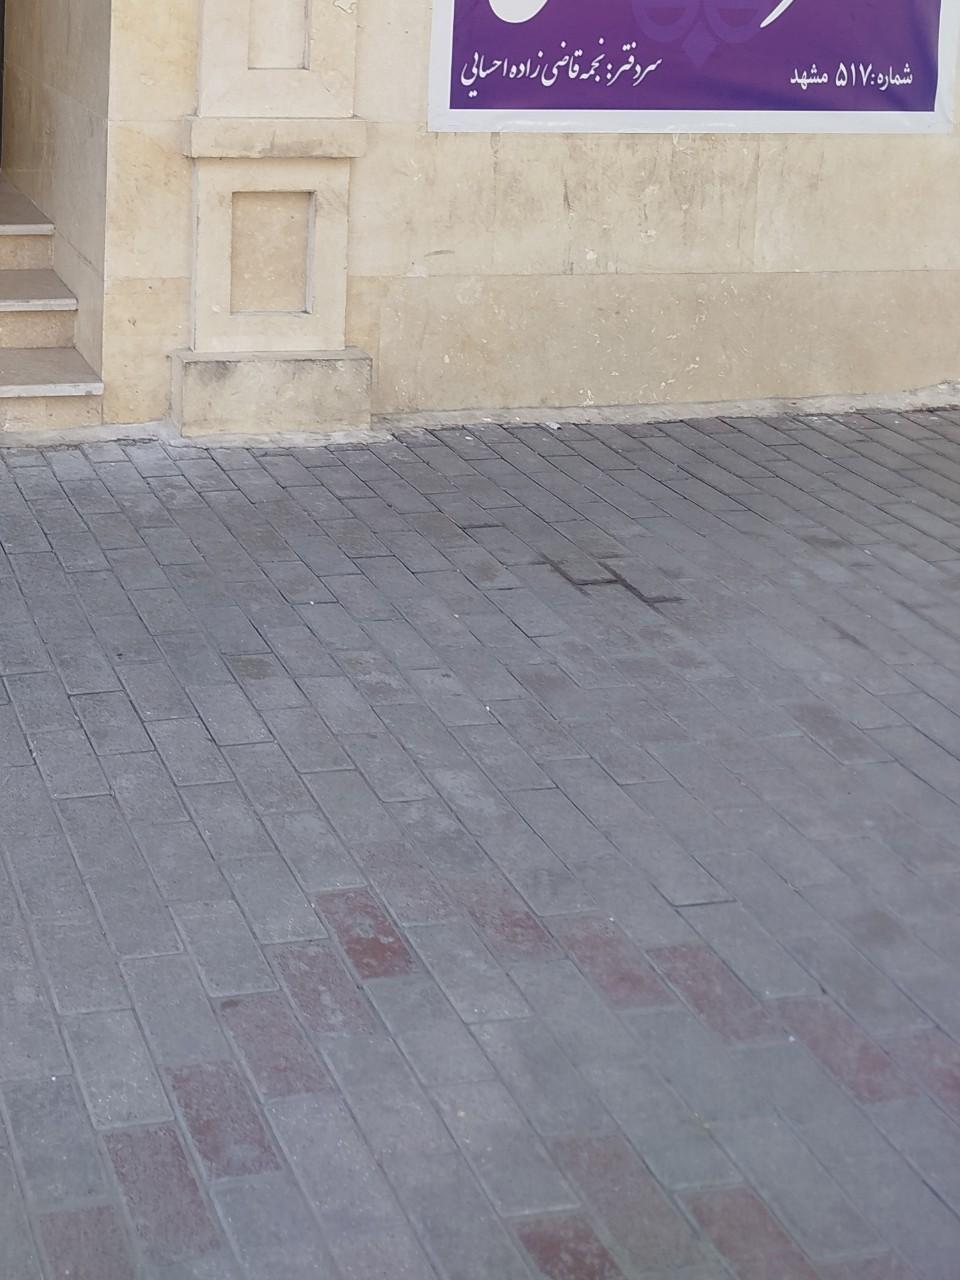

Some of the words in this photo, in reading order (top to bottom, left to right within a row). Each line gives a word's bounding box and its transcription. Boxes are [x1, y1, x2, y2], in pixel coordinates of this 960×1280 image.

[508, 49, 544, 79] زاده
[541, 40, 584, 87] قاضی
[579, 37, 606, 82] نجمه
[606, 41, 663, 87] سردفتر:
[790, 63, 829, 91] مشهد
